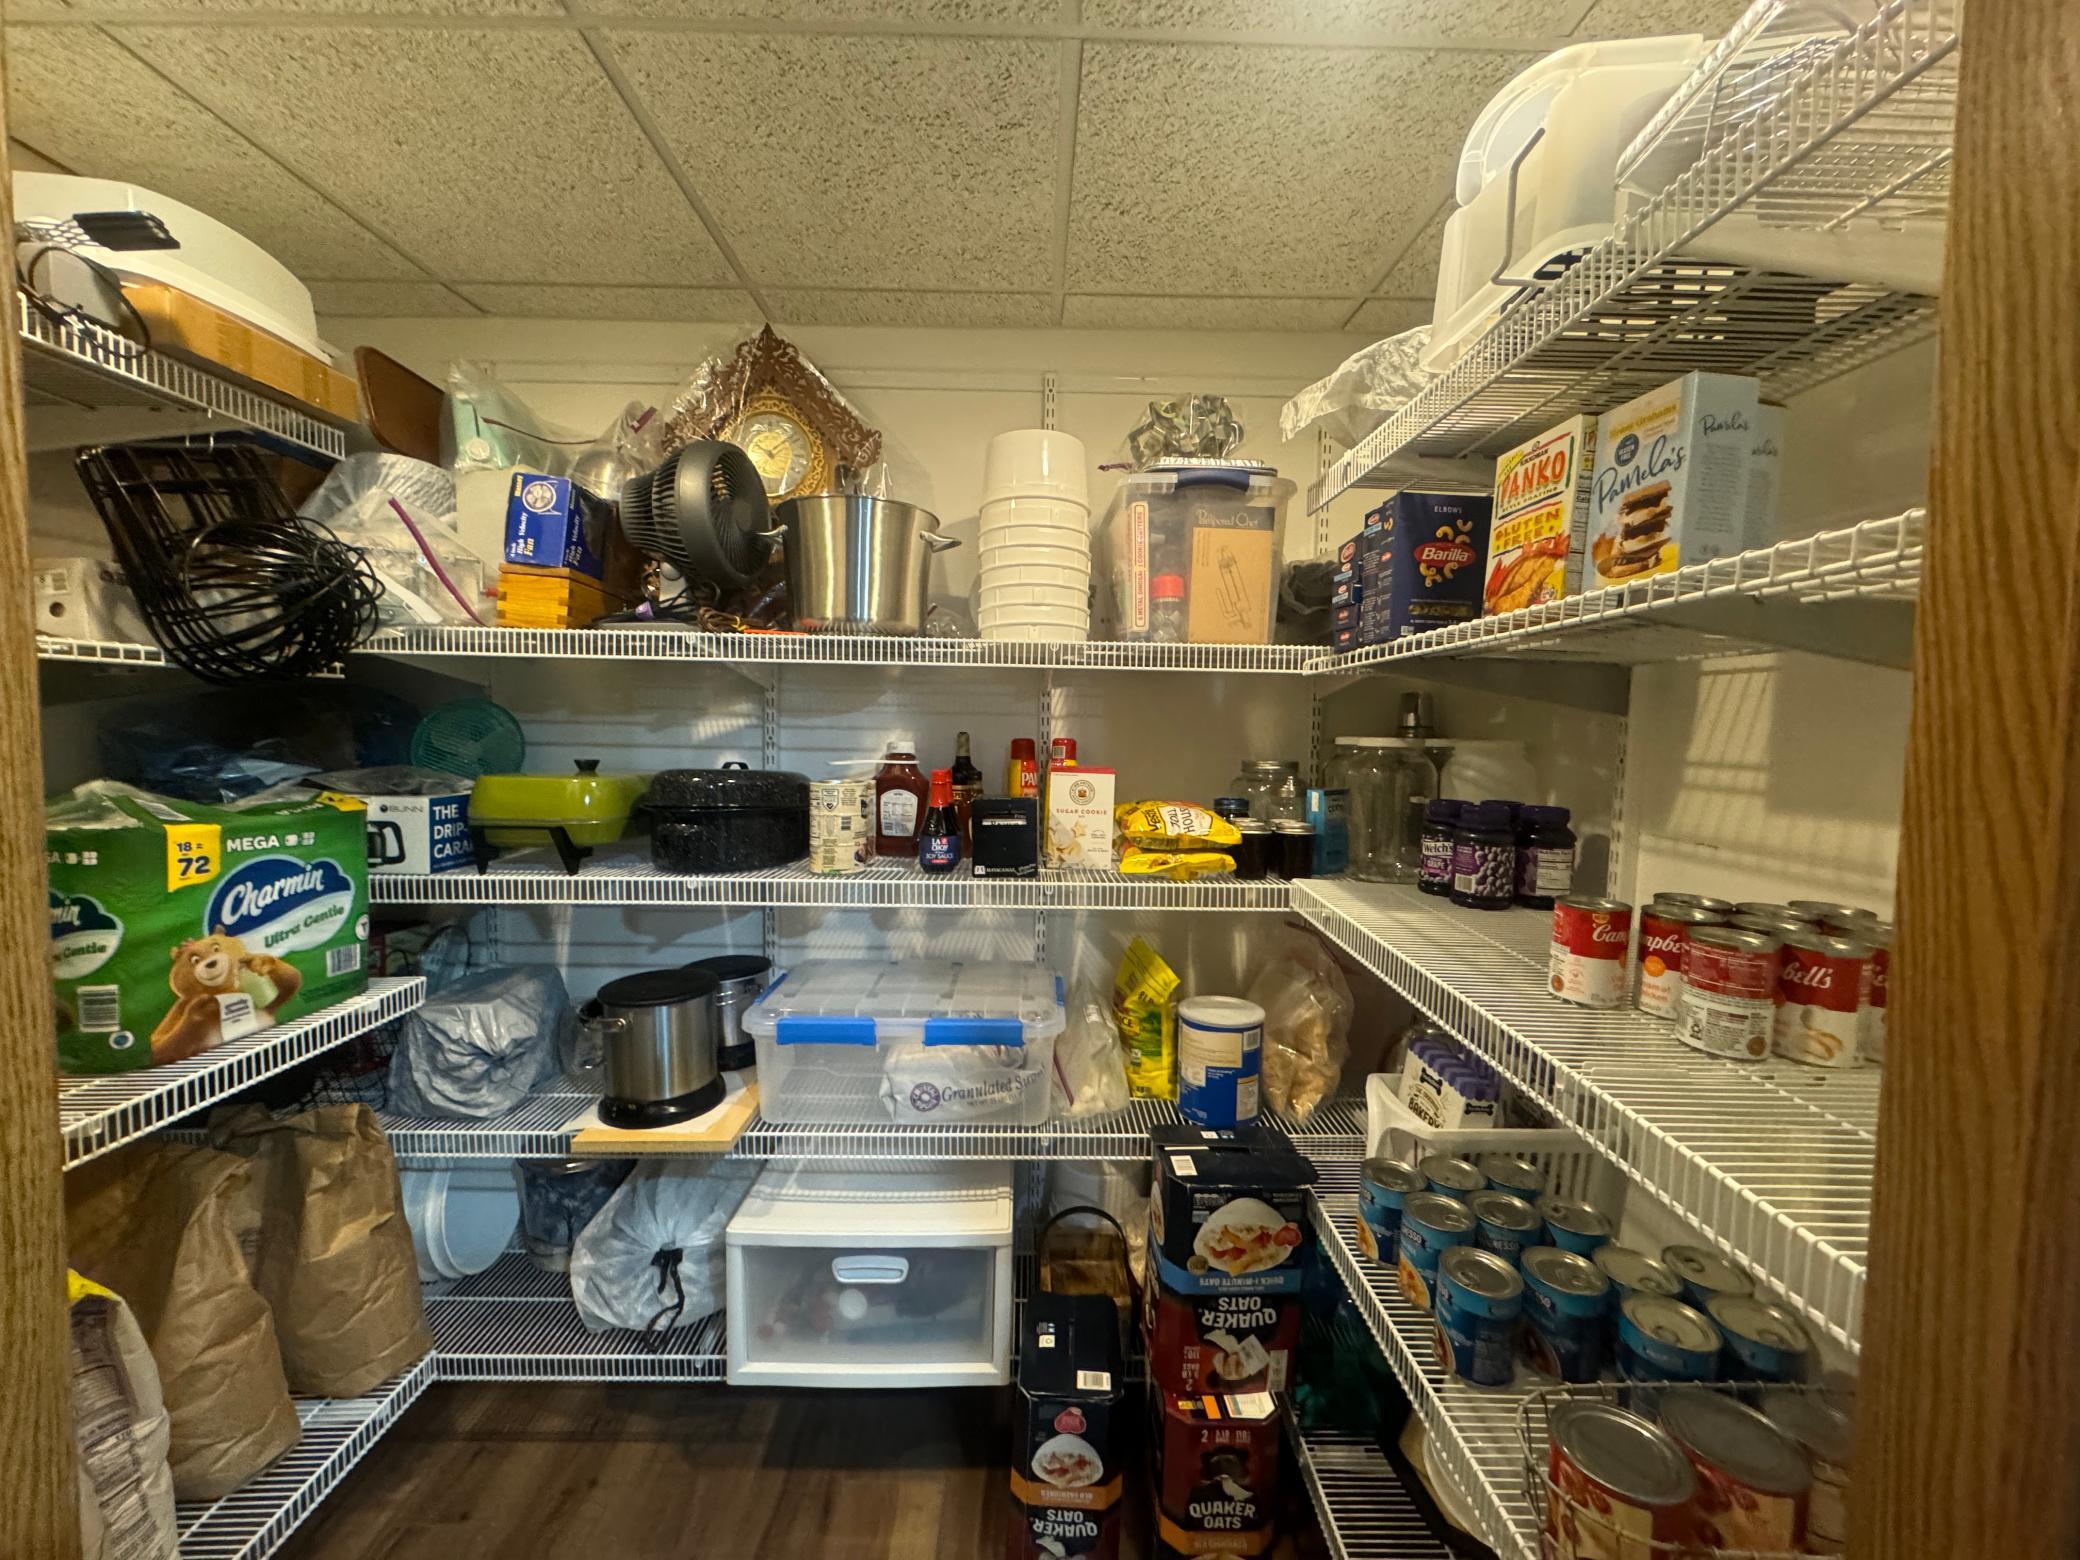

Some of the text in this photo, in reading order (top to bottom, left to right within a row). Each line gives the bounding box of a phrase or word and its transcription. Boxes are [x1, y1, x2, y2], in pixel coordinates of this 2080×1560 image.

[1500, 450, 1566, 508] PANKO
[1593, 435, 1686, 514] Pamela's
[1434, 505, 1463, 514] ELBOWS
[518, 512, 529, 536] Velocity
[1496, 508, 1561, 539] GLUTEN
[524, 538, 534, 556] Fan
[1422, 547, 1470, 562] Barilla
[389, 805, 424, 813] BUNN
[432, 804, 460, 820] THE
[1168, 808, 1180, 828] TOLL
[177, 842, 192, 852] 18
[226, 835, 280, 852] MEGA
[177, 856, 210, 877] 72
[221, 864, 324, 926] Charmin
[264, 904, 344, 948] Ultra Gentle
[1783, 962, 1833, 989] bell's
[941, 1079, 1012, 1102] Granulated
[1218, 1296, 1262, 1311] OATS
[1201, 1308, 1278, 1328] QUAKER
[1046, 1509, 1084, 1524] OATS
[1189, 1501, 1256, 1518] QUAKER
[1033, 1517, 1098, 1538] QUAKER
[1204, 1516, 1242, 1530] OATS
